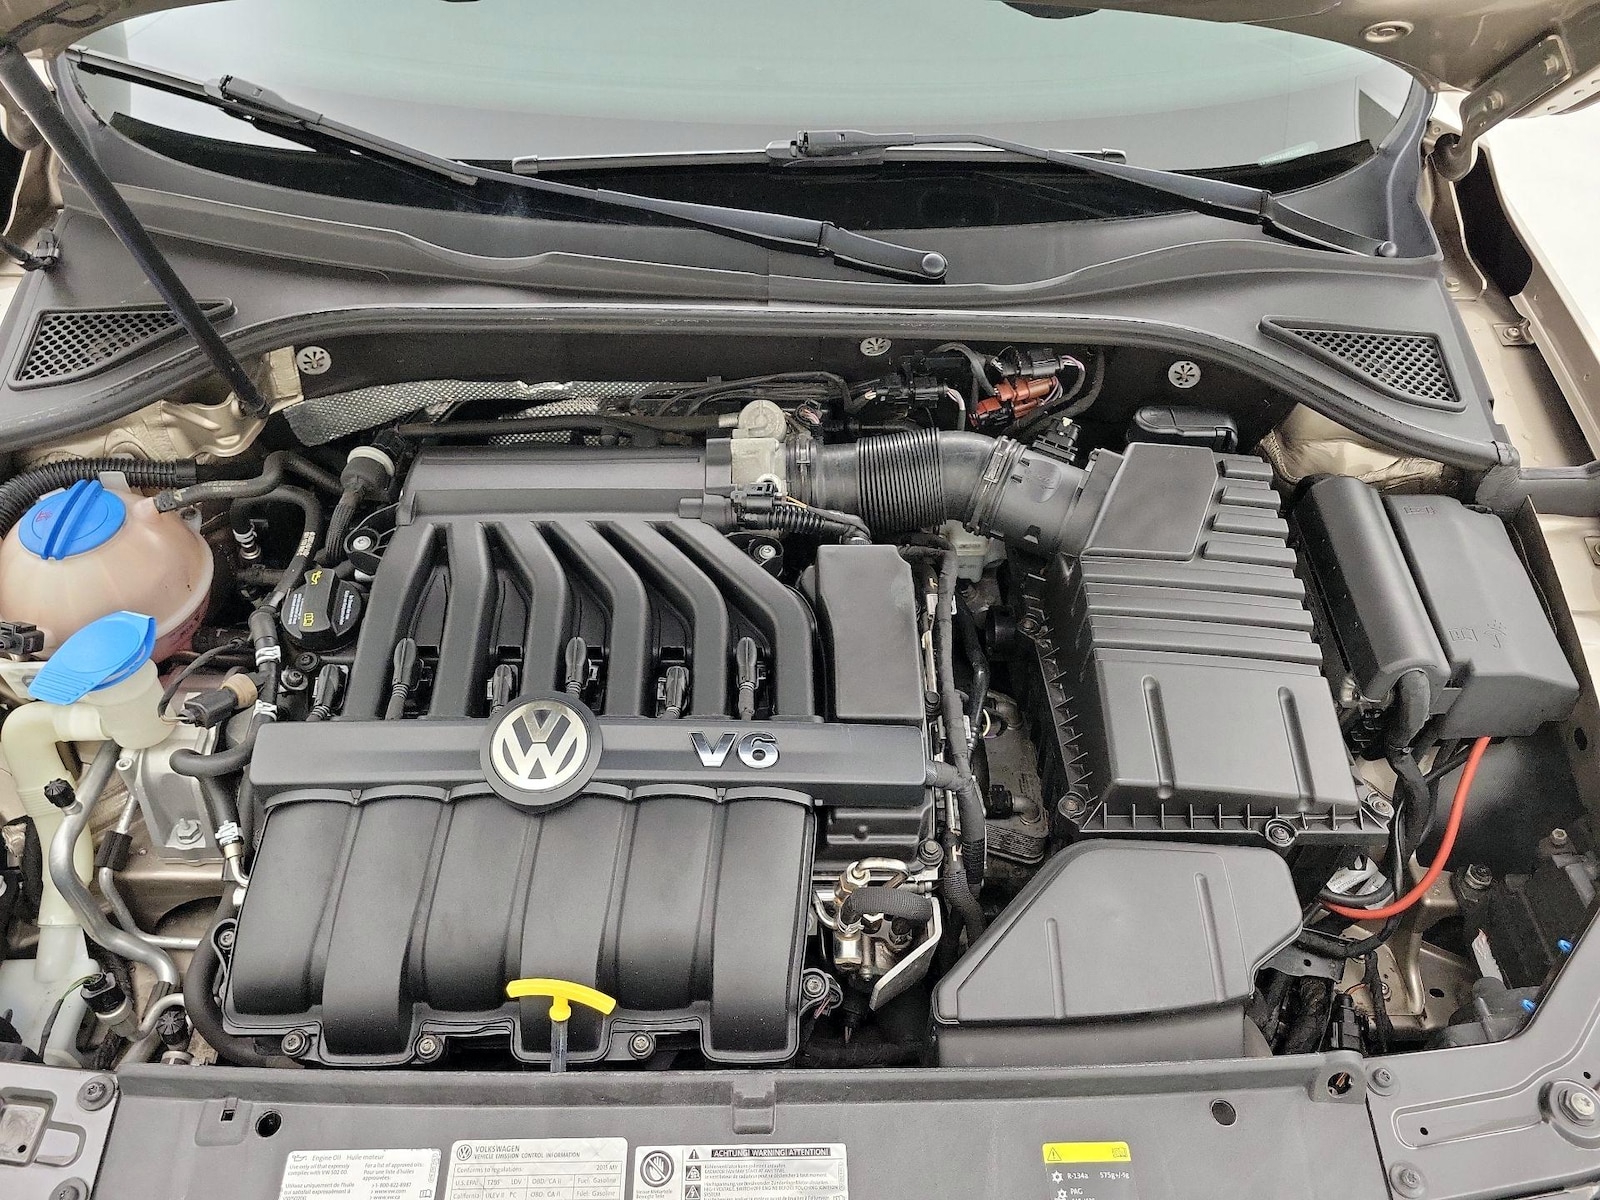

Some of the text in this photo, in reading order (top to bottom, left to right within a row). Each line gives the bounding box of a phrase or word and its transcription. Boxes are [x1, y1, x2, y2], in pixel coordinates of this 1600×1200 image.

[688, 730, 780, 768] V6
[713, 1148, 829, 1157] ACHTUNG! WARNING! ATTENTION!
[1067, 1172, 1089, 1180] R-134a
